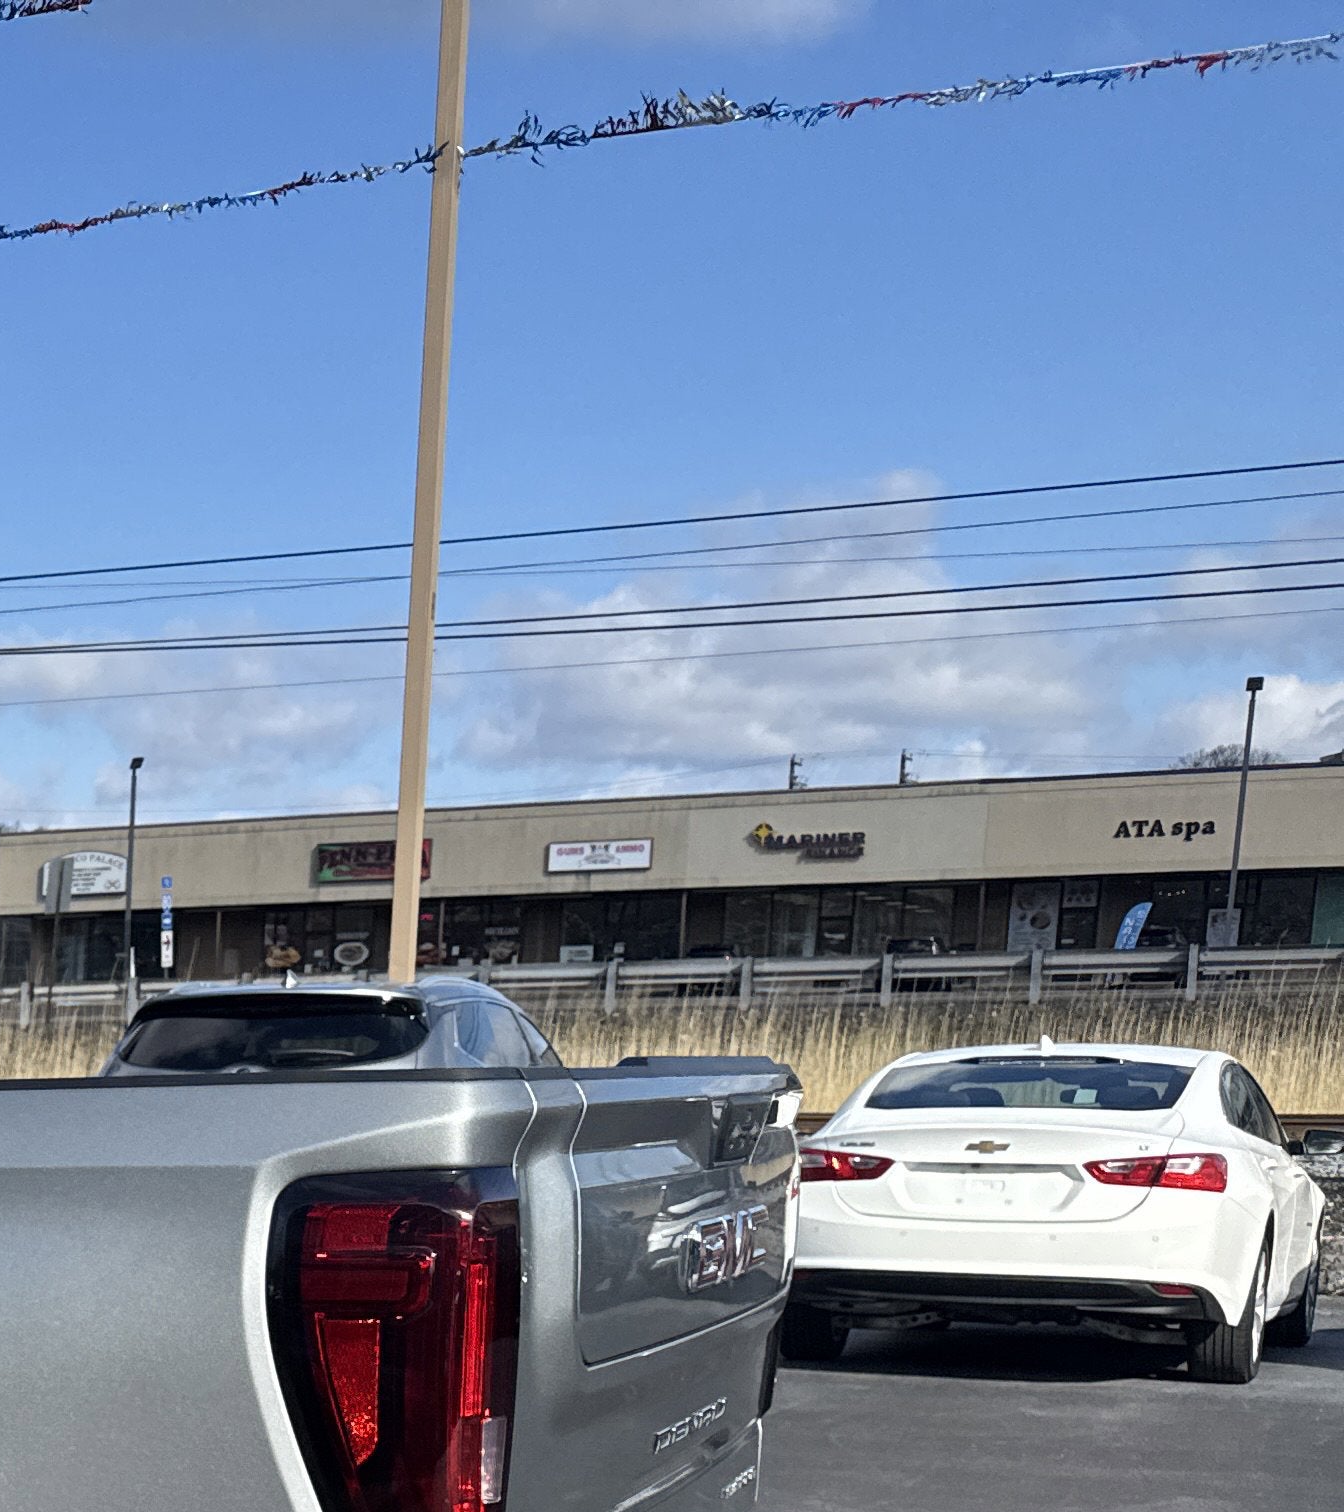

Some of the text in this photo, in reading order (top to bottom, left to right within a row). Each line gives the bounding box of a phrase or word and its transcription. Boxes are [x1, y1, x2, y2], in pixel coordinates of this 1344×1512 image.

[765, 831, 866, 849] MARINER
[1113, 819, 1216, 842] ATA spa
